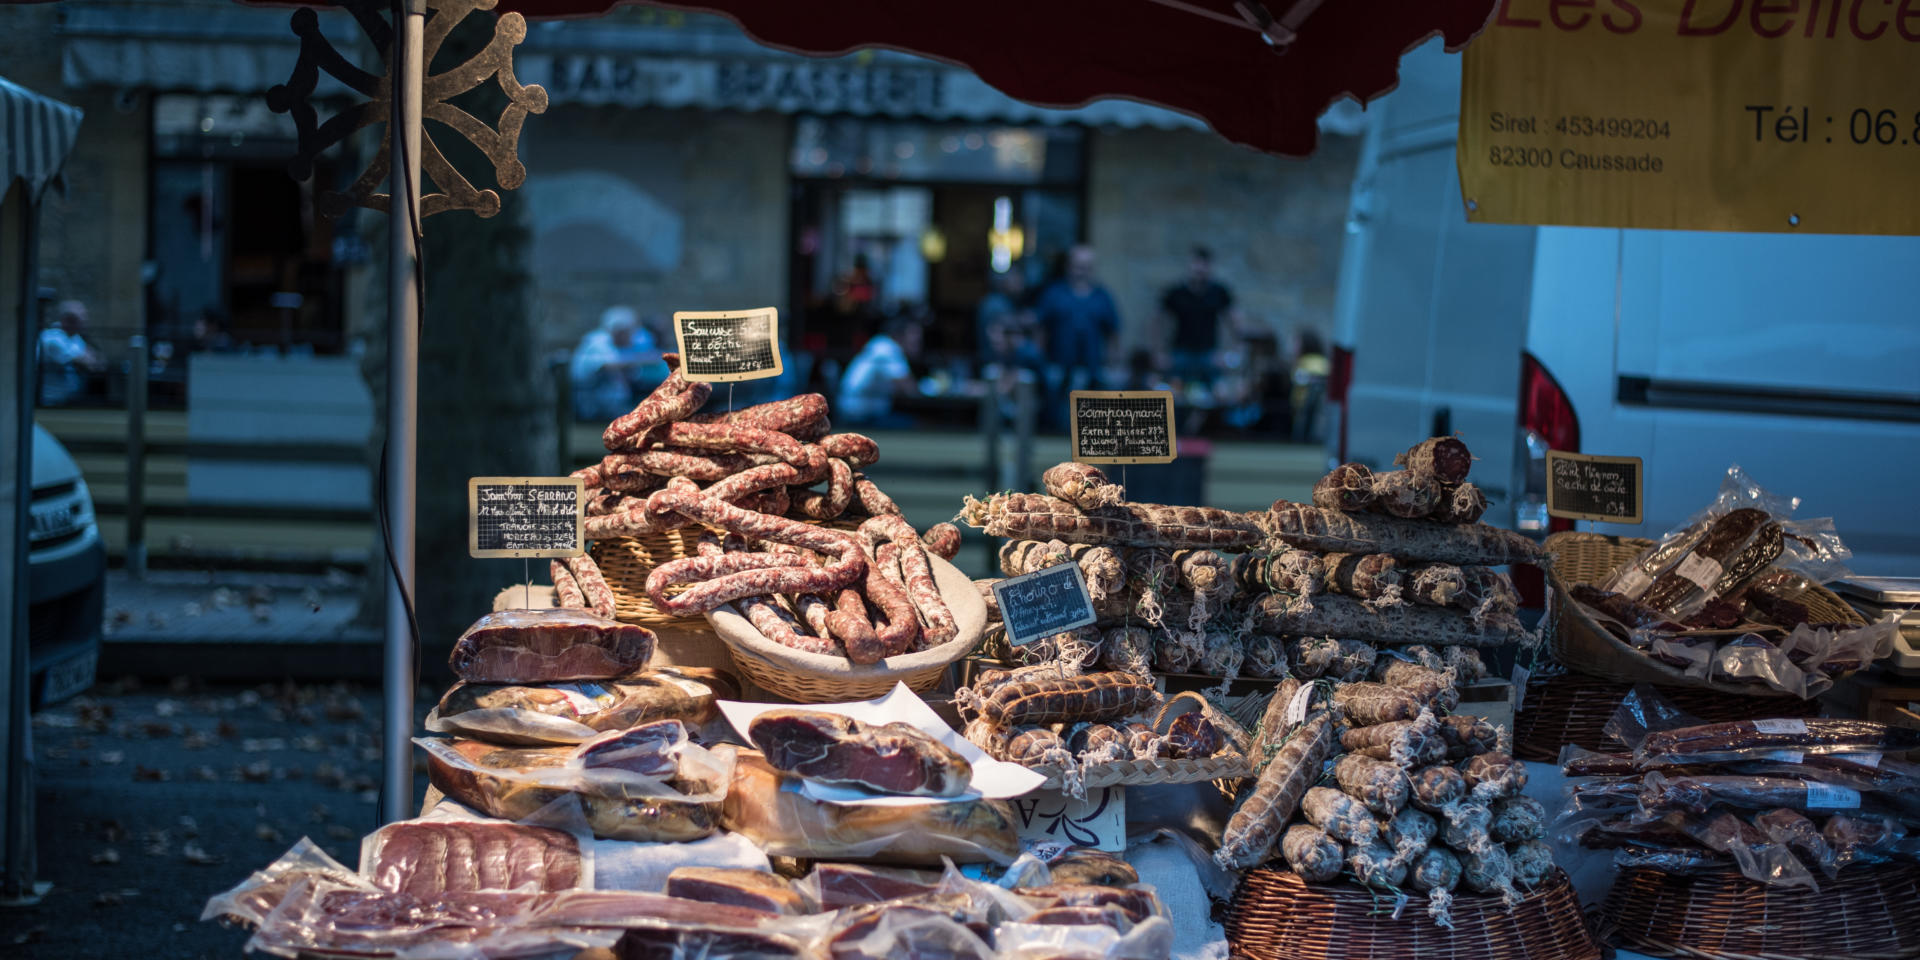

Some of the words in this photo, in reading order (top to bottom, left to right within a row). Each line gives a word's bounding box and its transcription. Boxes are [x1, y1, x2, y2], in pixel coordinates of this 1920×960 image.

[552, 57, 638, 94] BAR
[717, 61, 949, 108] BRASSERIE
[1489, 111, 1536, 135] Siret
[1554, 115, 1671, 140] 453499204
[1745, 105, 1808, 143] Tél
[1489, 145, 1553, 168] 82300
[1559, 147, 1664, 173] Caussade
[481, 485, 524, 502] Jambon
[527, 488, 577, 502] SERRANO
